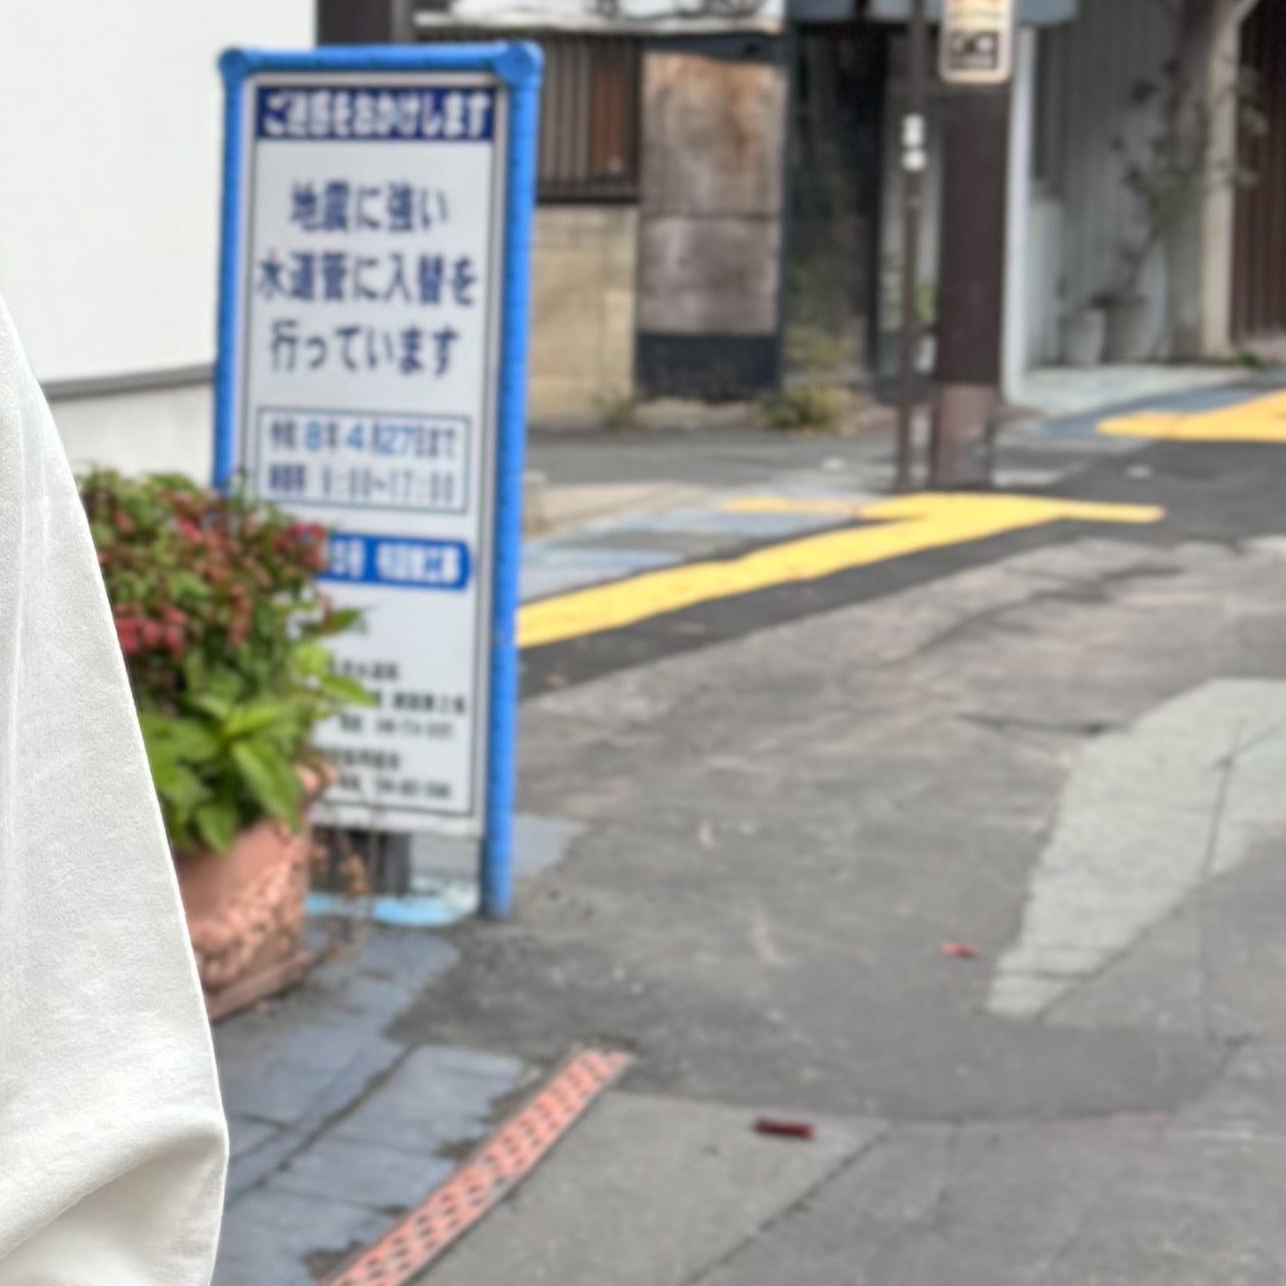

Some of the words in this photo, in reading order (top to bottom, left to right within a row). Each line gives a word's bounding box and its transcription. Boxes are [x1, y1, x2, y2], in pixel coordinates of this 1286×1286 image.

[290, 181, 449, 233] 地震に強い
[257, 251, 477, 306] 水道管に入替を
[270, 319, 459, 377] 行っています
